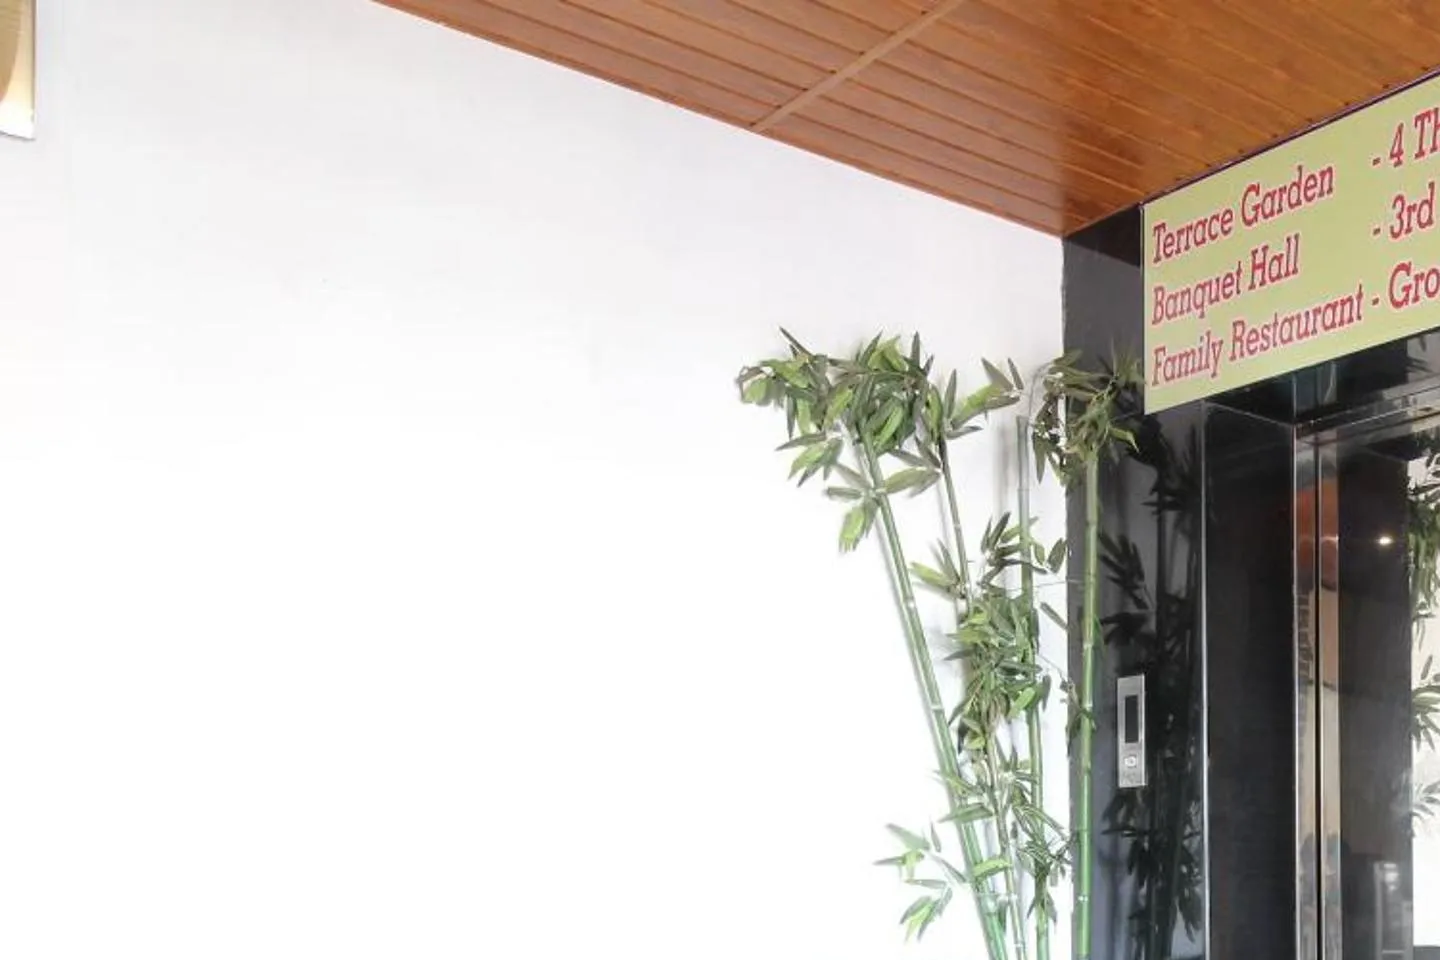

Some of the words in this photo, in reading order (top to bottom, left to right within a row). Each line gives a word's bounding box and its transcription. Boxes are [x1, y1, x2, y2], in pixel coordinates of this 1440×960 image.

[1151, 260, 1243, 325] Banquet
[1247, 233, 1300, 291] Hall
[1389, 181, 1435, 240] 3rd
[1152, 208, 1234, 264] Terrace
[1240, 166, 1334, 227] Garden
[1389, 122, 1405, 168] 4
[1151, 330, 1224, 386] Family
[1229, 283, 1364, 362] Restaurant
